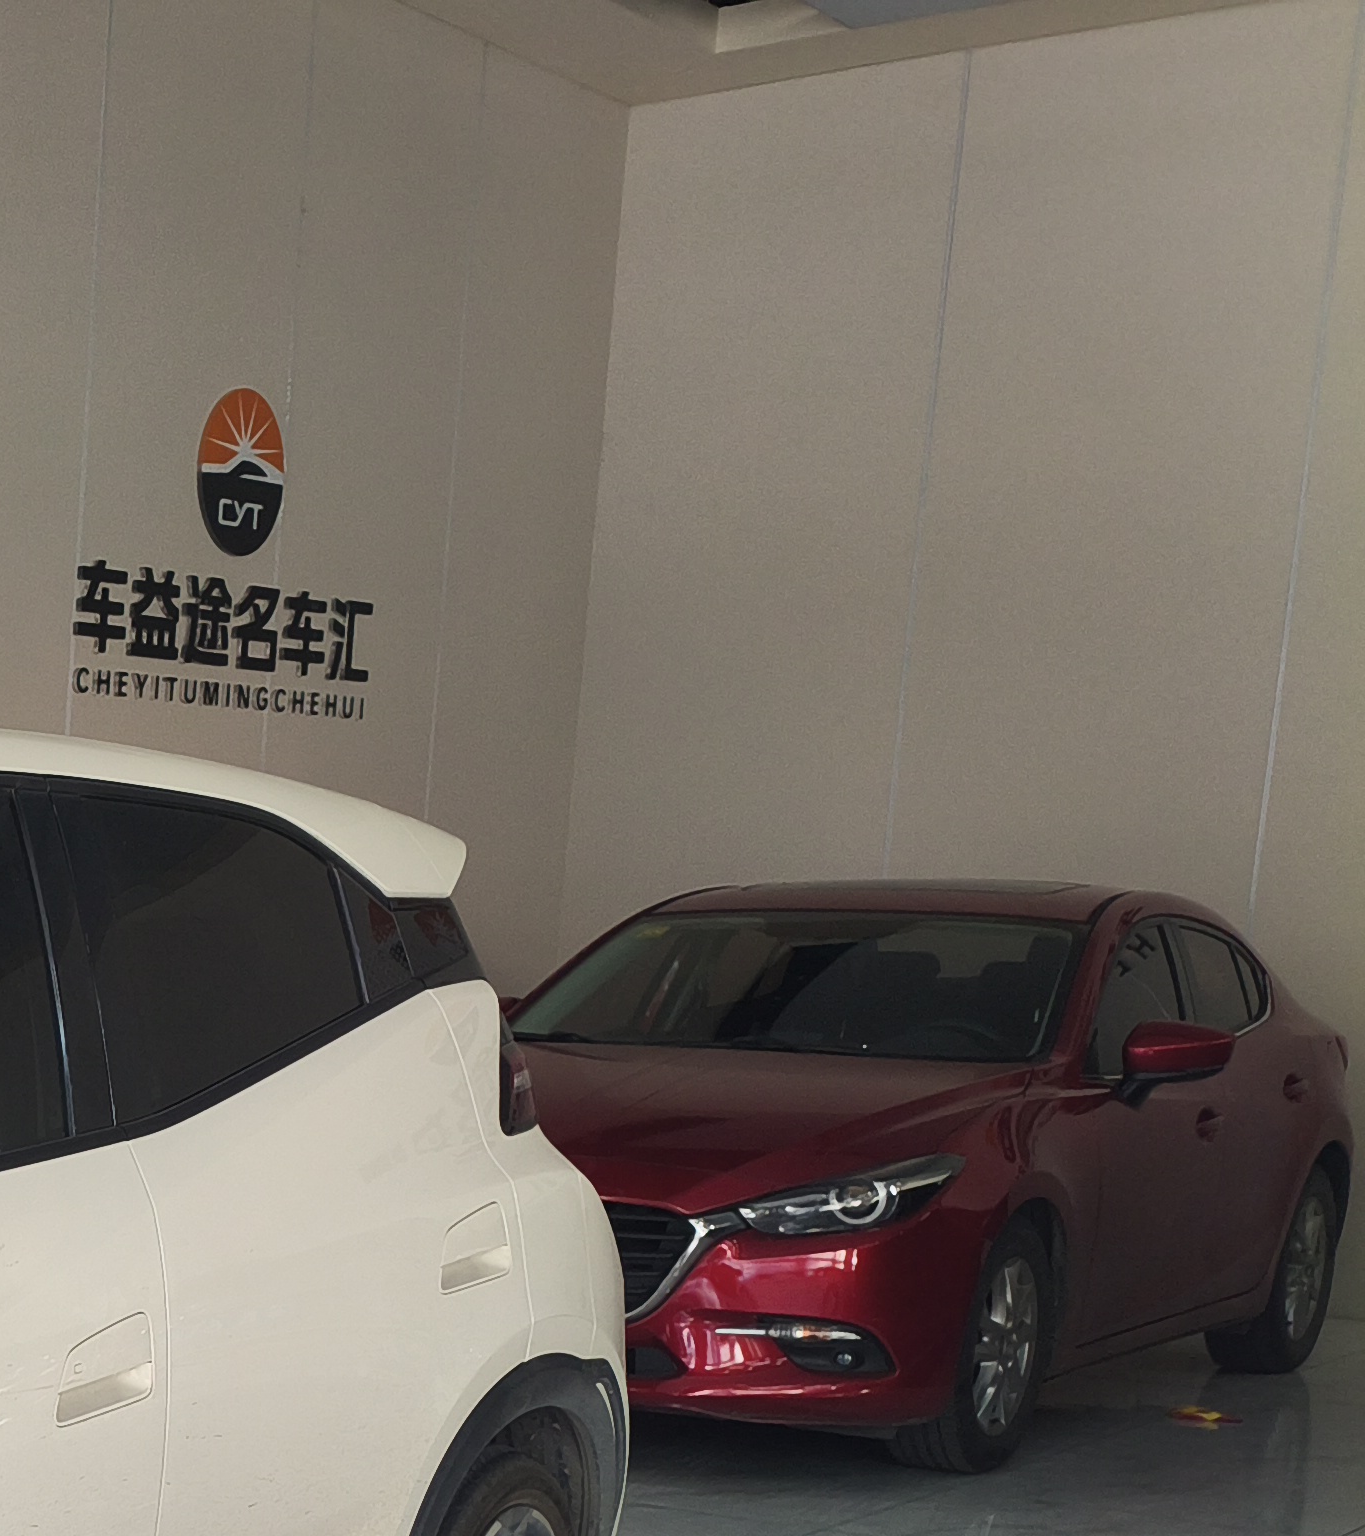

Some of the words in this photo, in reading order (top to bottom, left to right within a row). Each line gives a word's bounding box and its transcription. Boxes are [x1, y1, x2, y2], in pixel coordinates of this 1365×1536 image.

[218, 498, 263, 531] CYT
[72, 559, 374, 683] 车益途名车汇
[73, 666, 366, 720] CHEYITUMINGCHEHUI
